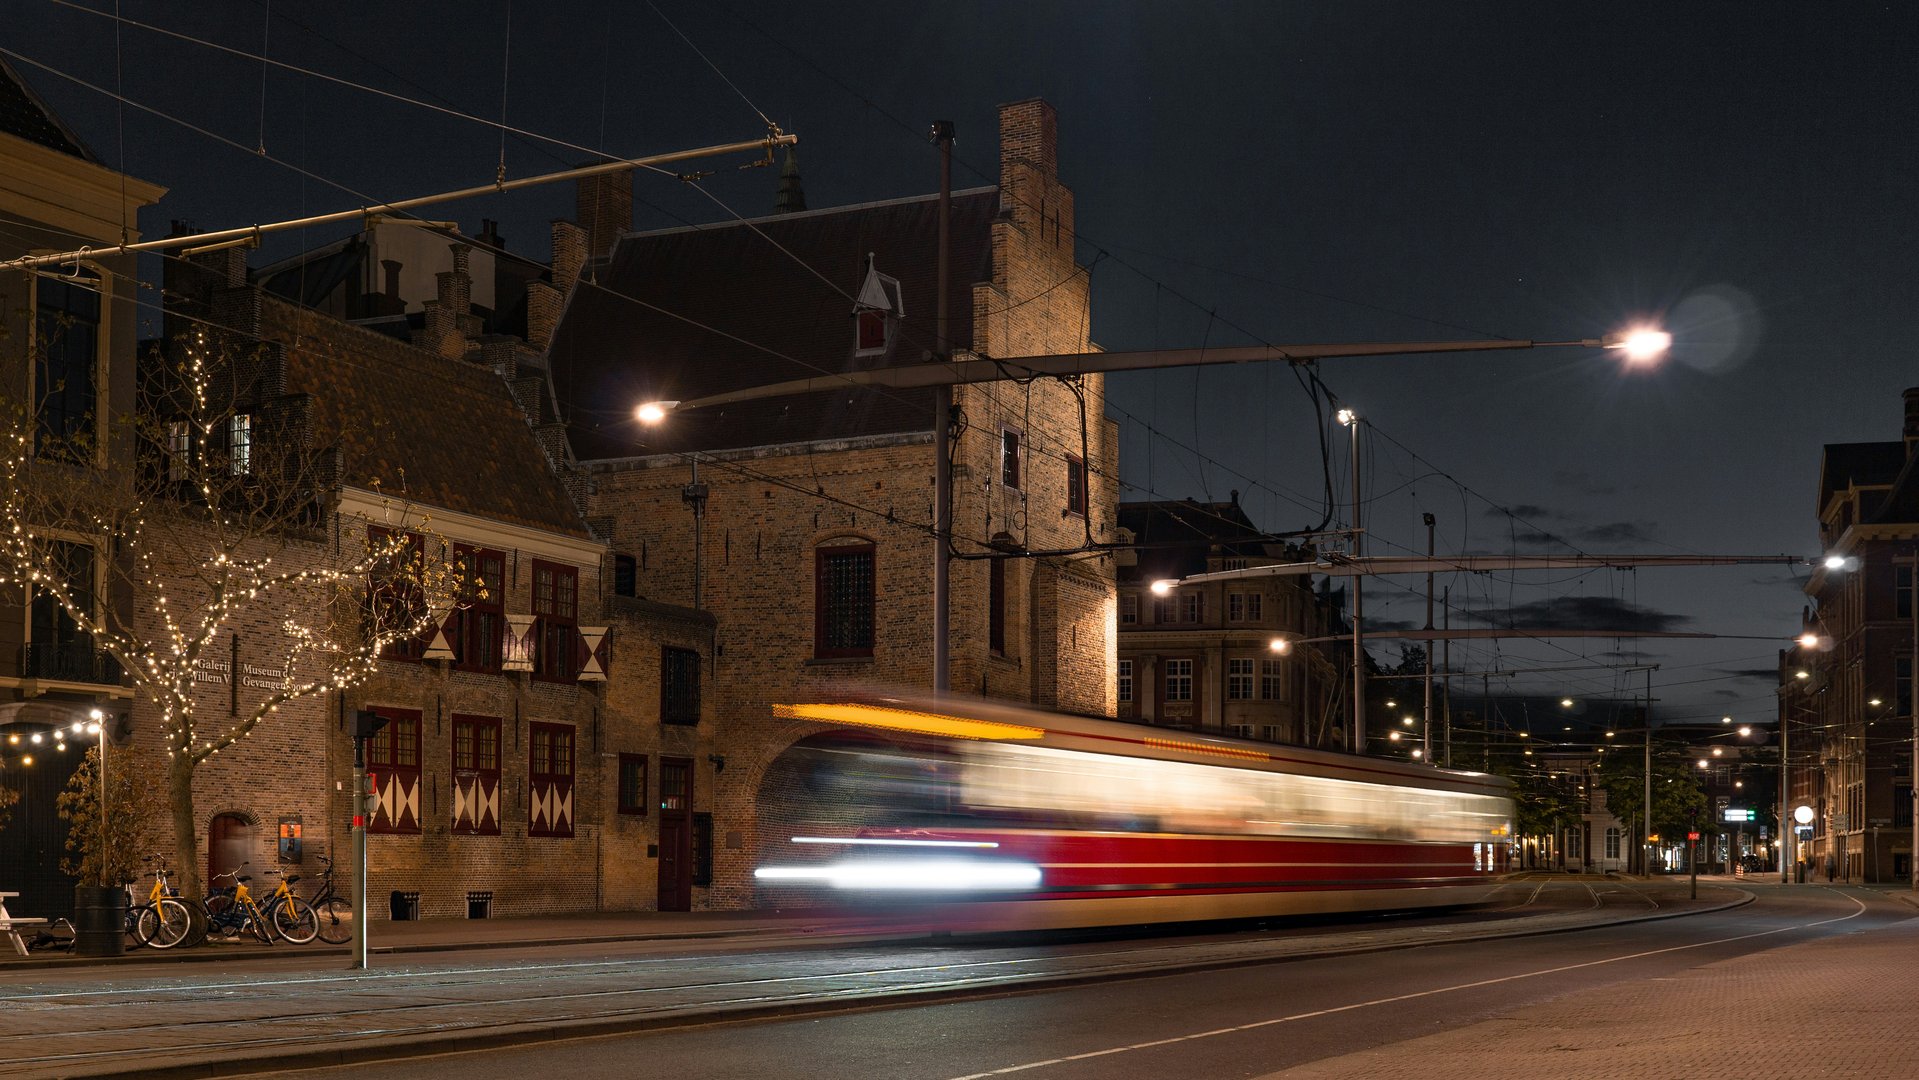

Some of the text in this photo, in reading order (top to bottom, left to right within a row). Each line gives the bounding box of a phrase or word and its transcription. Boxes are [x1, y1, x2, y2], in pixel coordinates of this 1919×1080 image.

[198, 658, 230, 673] Galerij
[242, 664, 281, 677] Museum
[224, 674, 231, 684] V
